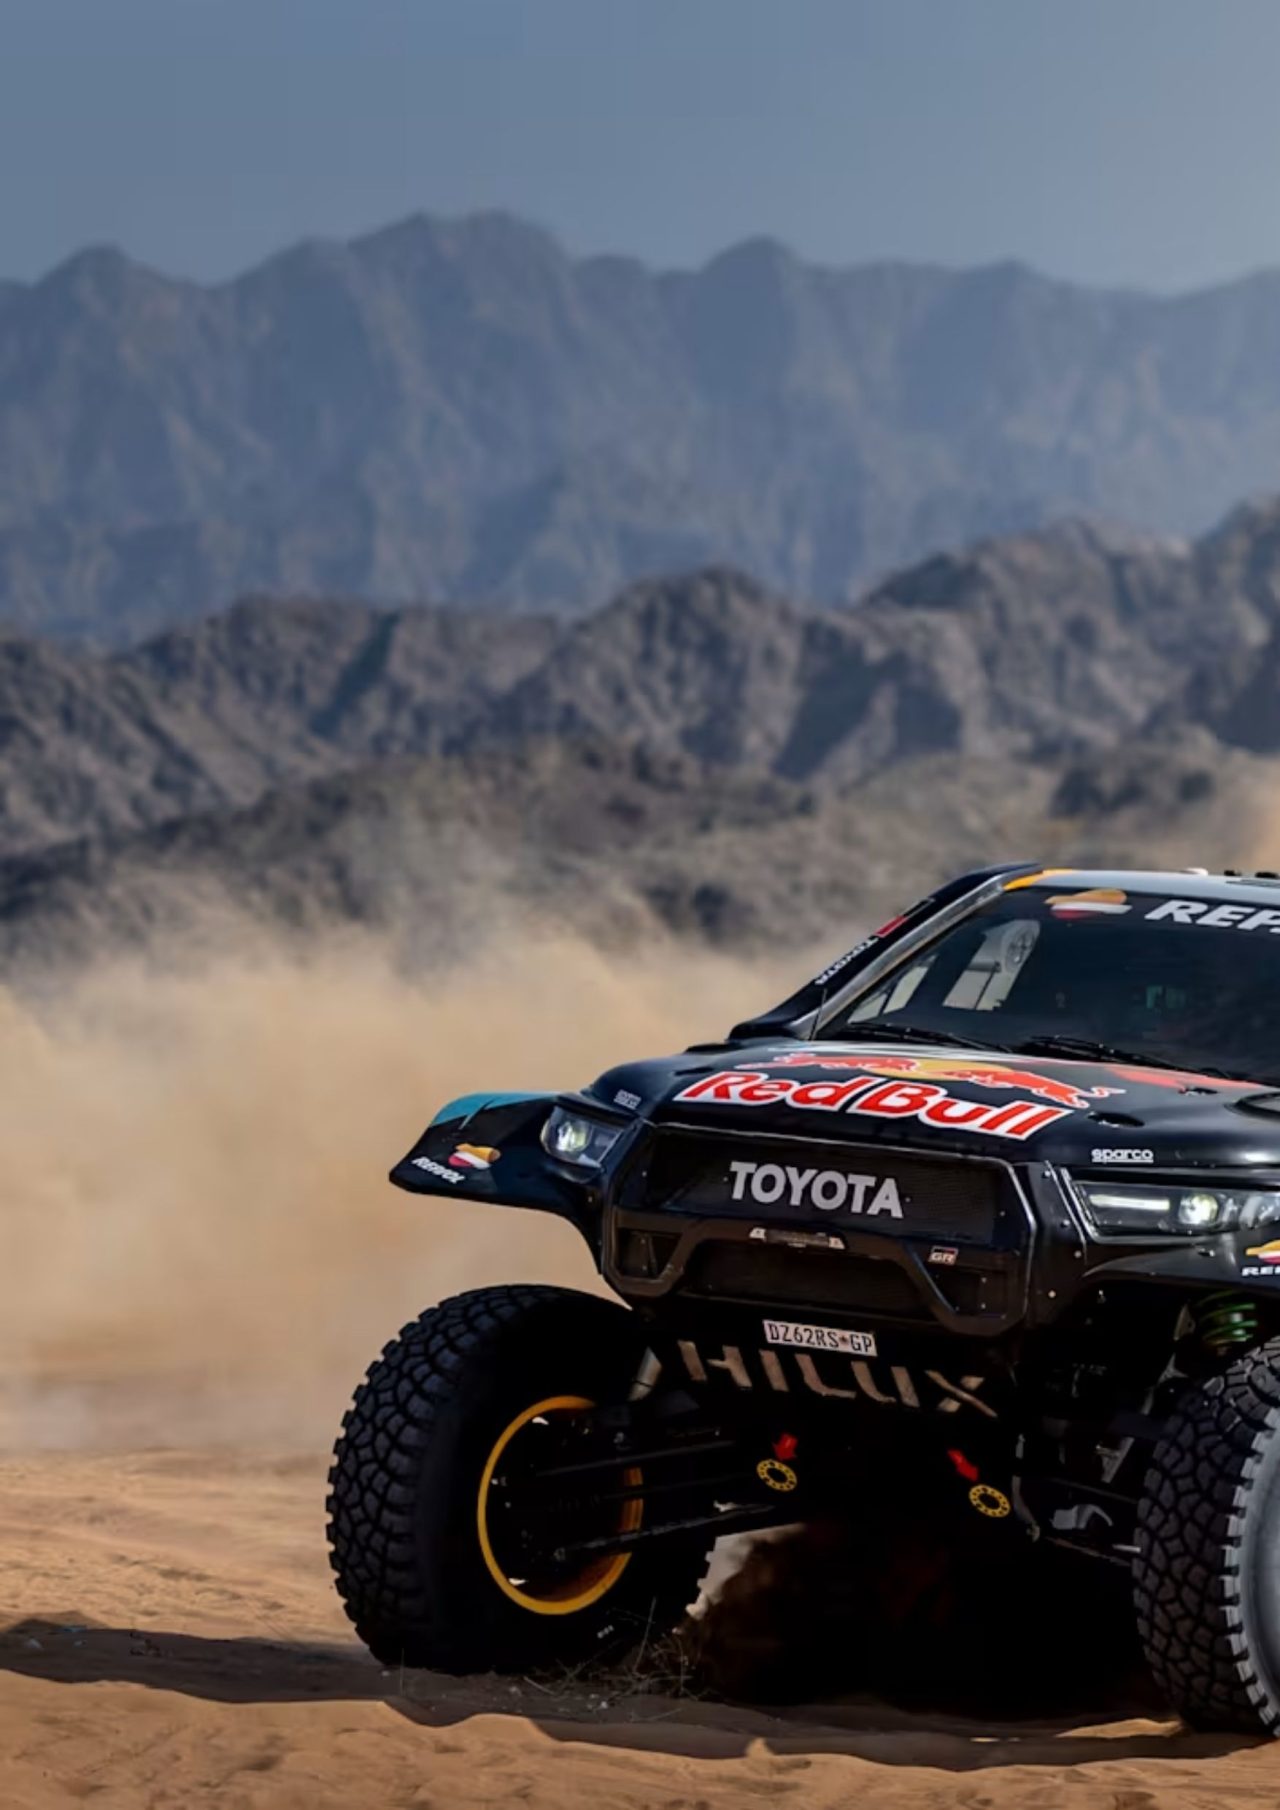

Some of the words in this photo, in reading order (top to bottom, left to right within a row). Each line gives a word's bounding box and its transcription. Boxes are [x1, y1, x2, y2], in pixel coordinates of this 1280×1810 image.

[675, 1071, 874, 1111] Red
[847, 1081, 1073, 1140] Bull
[1090, 1148, 1154, 1164] sparco
[729, 1160, 904, 1219] TOYOTA
[766, 1321, 840, 1349] DZ62RS
[850, 1333, 873, 1353] GP
[677, 1339, 998, 1418] HILUX
